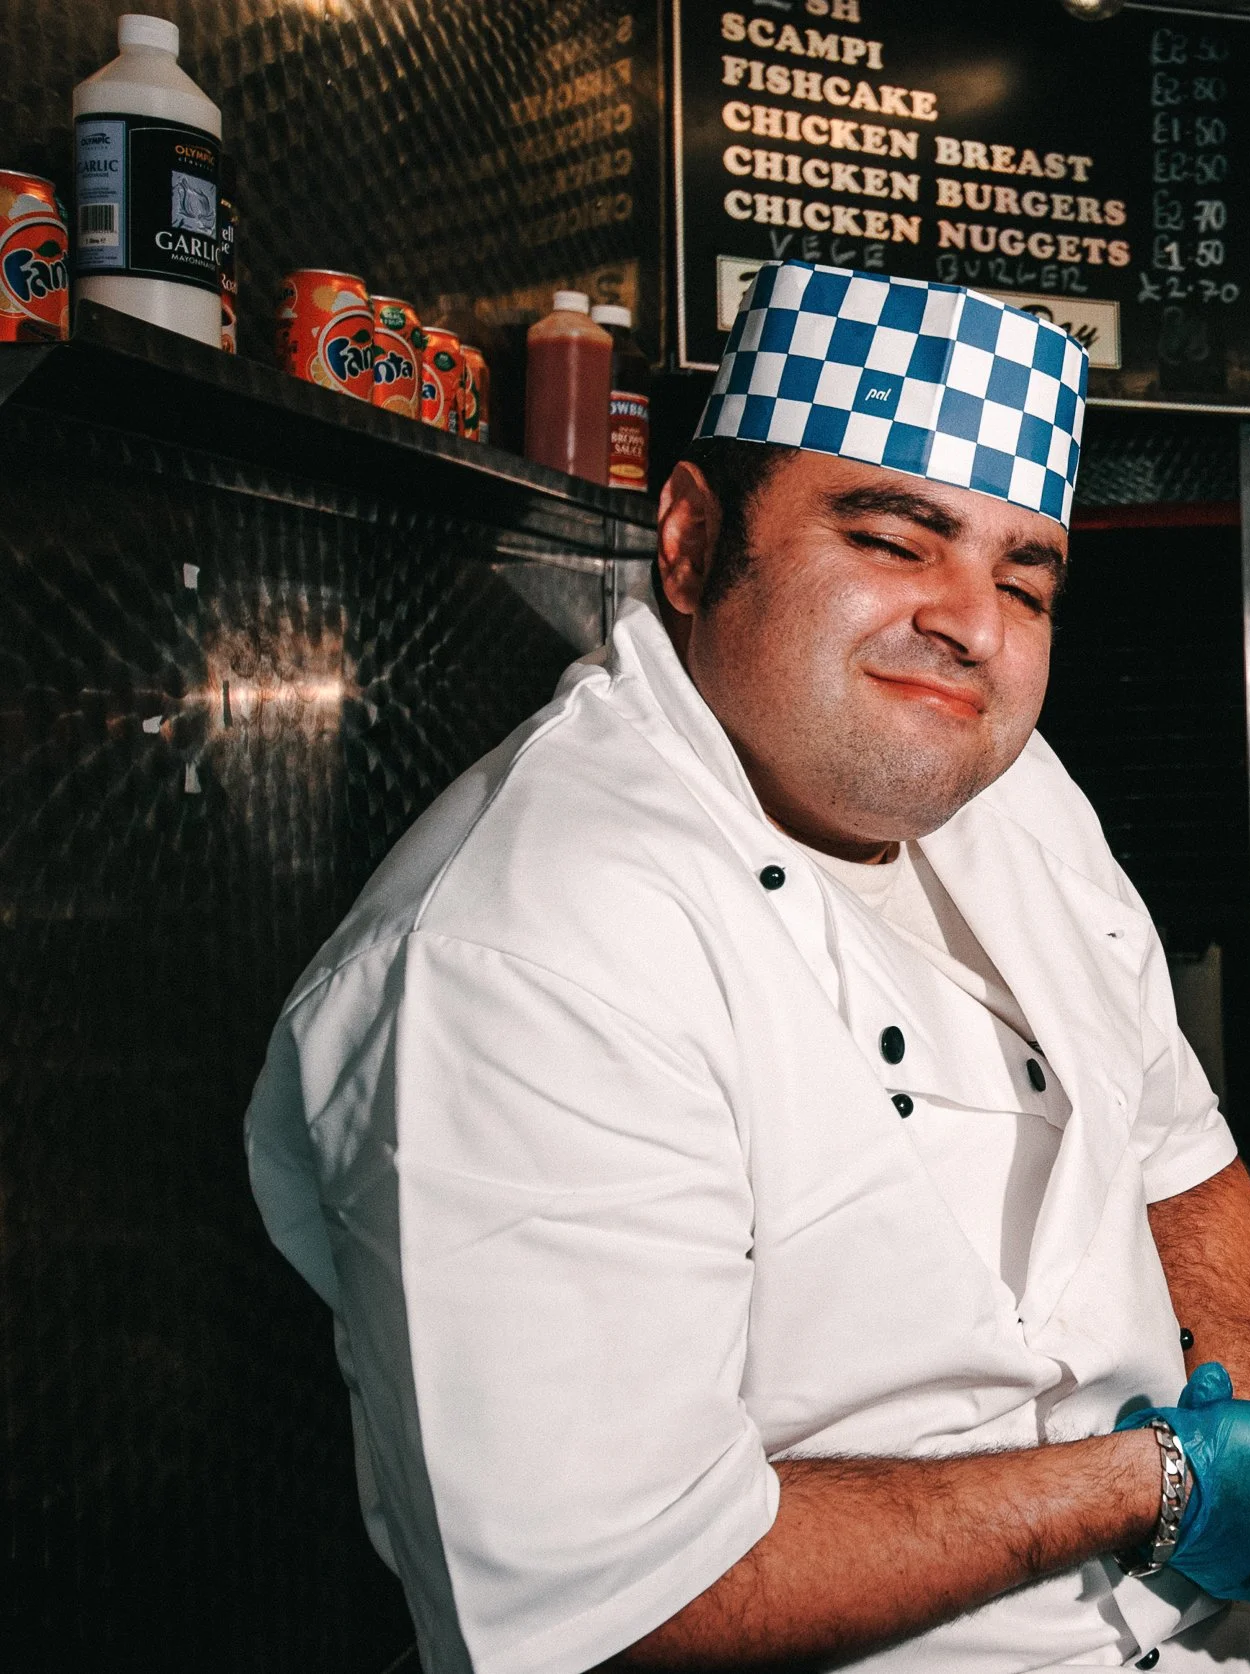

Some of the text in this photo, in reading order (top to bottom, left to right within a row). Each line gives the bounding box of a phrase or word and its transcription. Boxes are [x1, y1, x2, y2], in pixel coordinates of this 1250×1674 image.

[721, 11, 884, 70] SCAMPI
[720, 55, 938, 122] FISHCAKE
[722, 100, 1093, 182] CHICKEN BREAST
[722, 144, 1128, 227] CHICKEN BURGERS
[723, 189, 1132, 267] CHICKEN NUGGETS
[865, 388, 892, 402] pal
